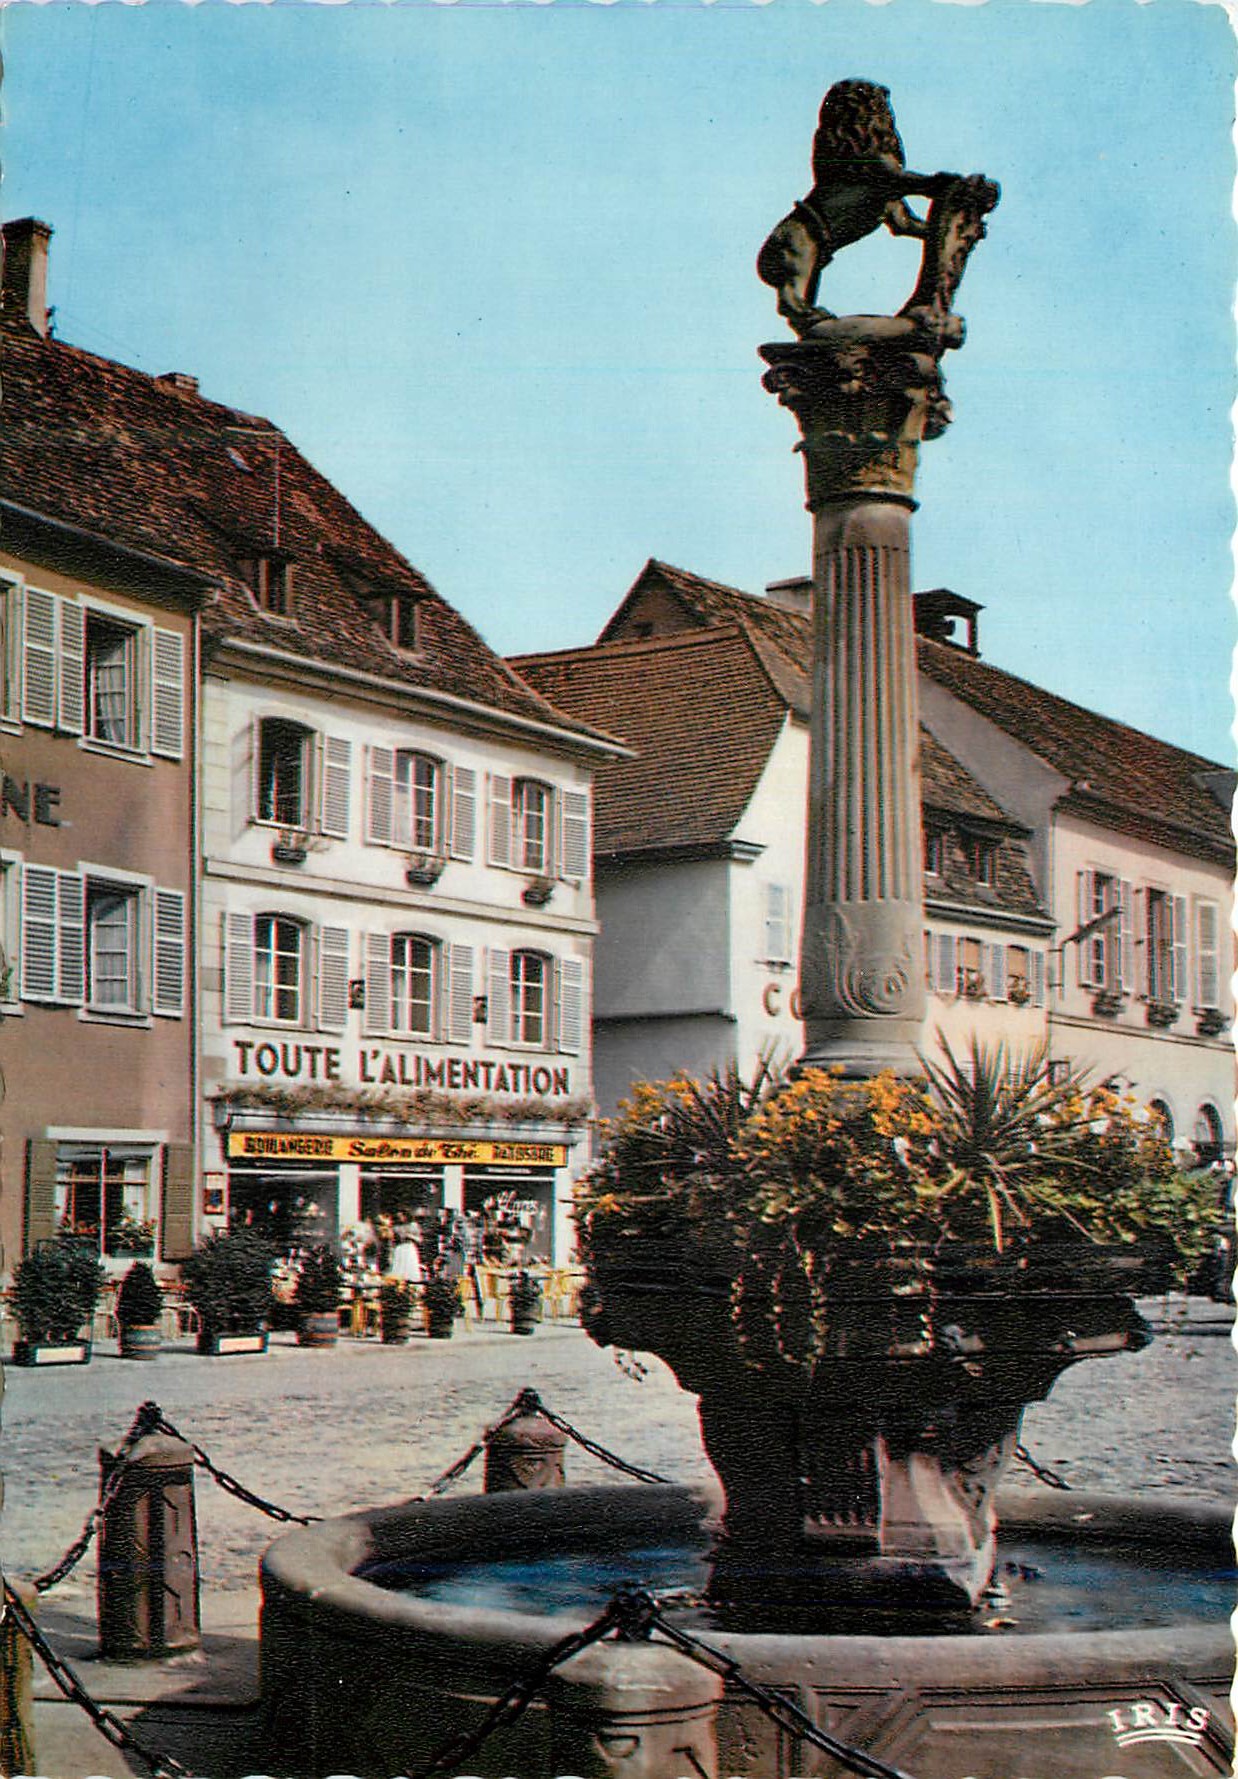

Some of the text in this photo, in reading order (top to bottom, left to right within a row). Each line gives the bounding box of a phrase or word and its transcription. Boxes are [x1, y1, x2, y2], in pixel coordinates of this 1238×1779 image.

[233, 1040, 569, 1095] TOUTE L'ALIMENTATION
[348, 1140, 411, 1158] Salon
